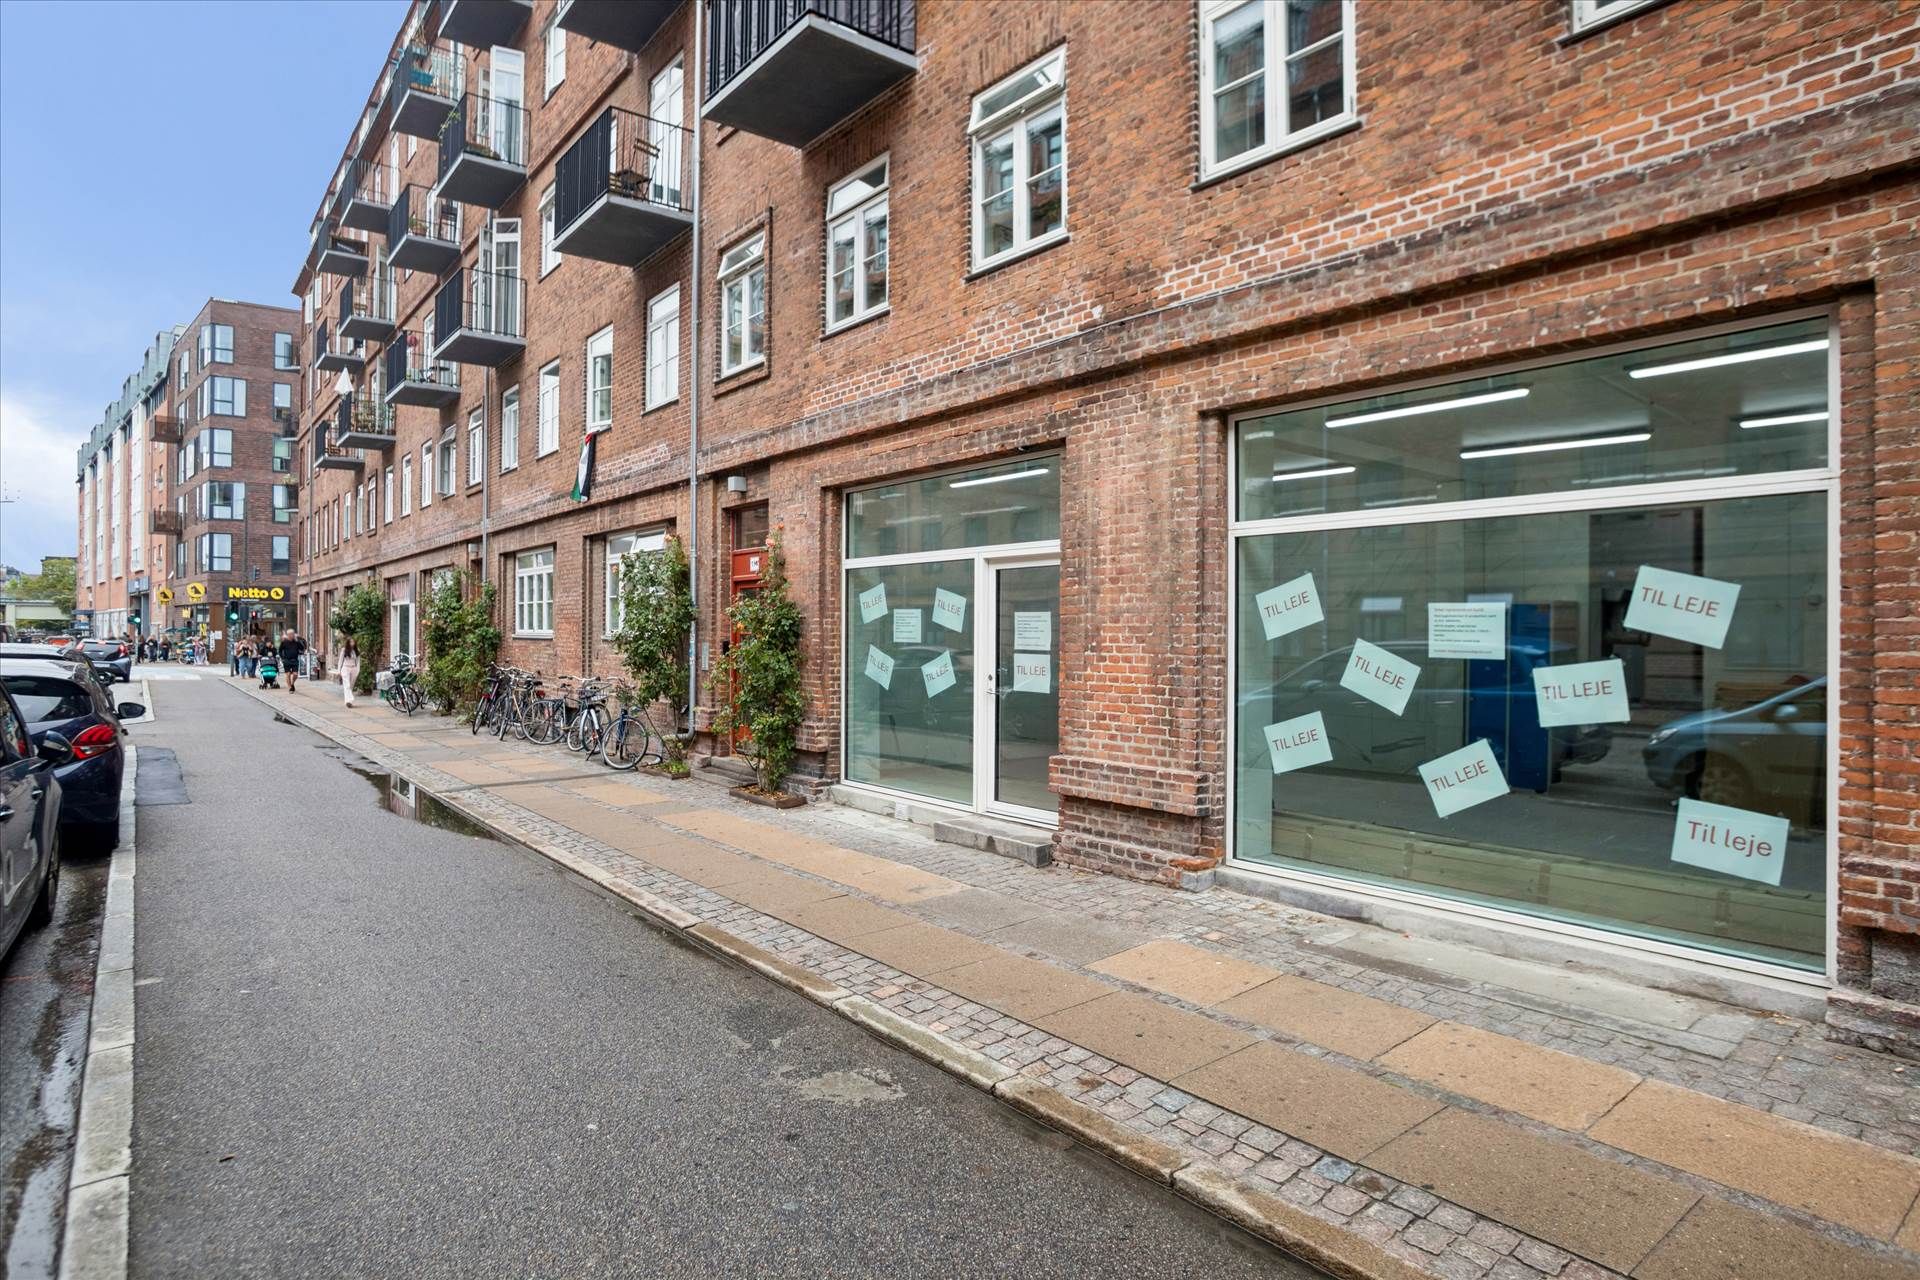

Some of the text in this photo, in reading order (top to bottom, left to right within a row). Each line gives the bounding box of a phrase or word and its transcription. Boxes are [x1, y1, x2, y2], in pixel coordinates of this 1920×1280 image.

[229, 587, 269, 598] Netto
[1642, 586, 1721, 617] TIL LEJE
[937, 599, 946, 611] TIL
[1264, 591, 1310, 618] TIL LEJE
[925, 673, 936, 682] TIL
[1016, 665, 1028, 676] TIL
[1355, 655, 1406, 690] TIL LEJE
[1542, 680, 1613, 700] TIL LEJE
[1272, 728, 1319, 751] TIL LEJE
[1431, 759, 1489, 792] TIL LEJE
[1688, 820, 1772, 858] Til leje
